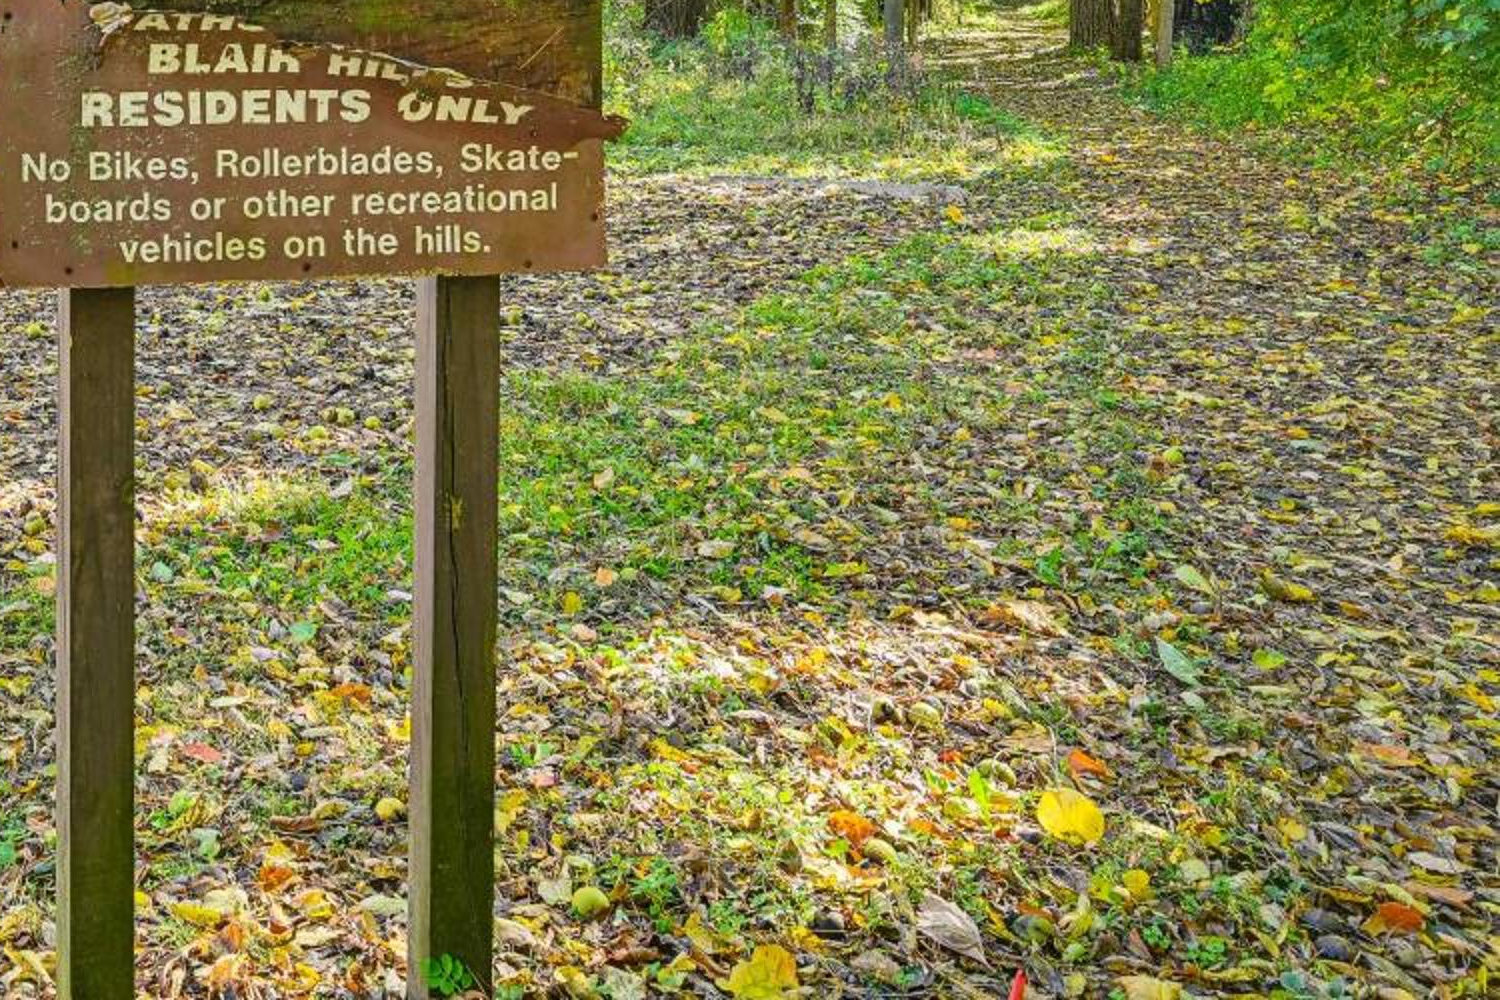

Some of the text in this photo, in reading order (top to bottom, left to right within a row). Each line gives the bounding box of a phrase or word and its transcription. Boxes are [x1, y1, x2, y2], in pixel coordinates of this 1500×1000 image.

[81, 90, 534, 127] RESIDENTS ONLY
[21, 143, 580, 185] No Bikes, Rollerblades, Skate-
[45, 183, 558, 223] boards or other recreational
[119, 224, 493, 264] vehicles on the hills.
